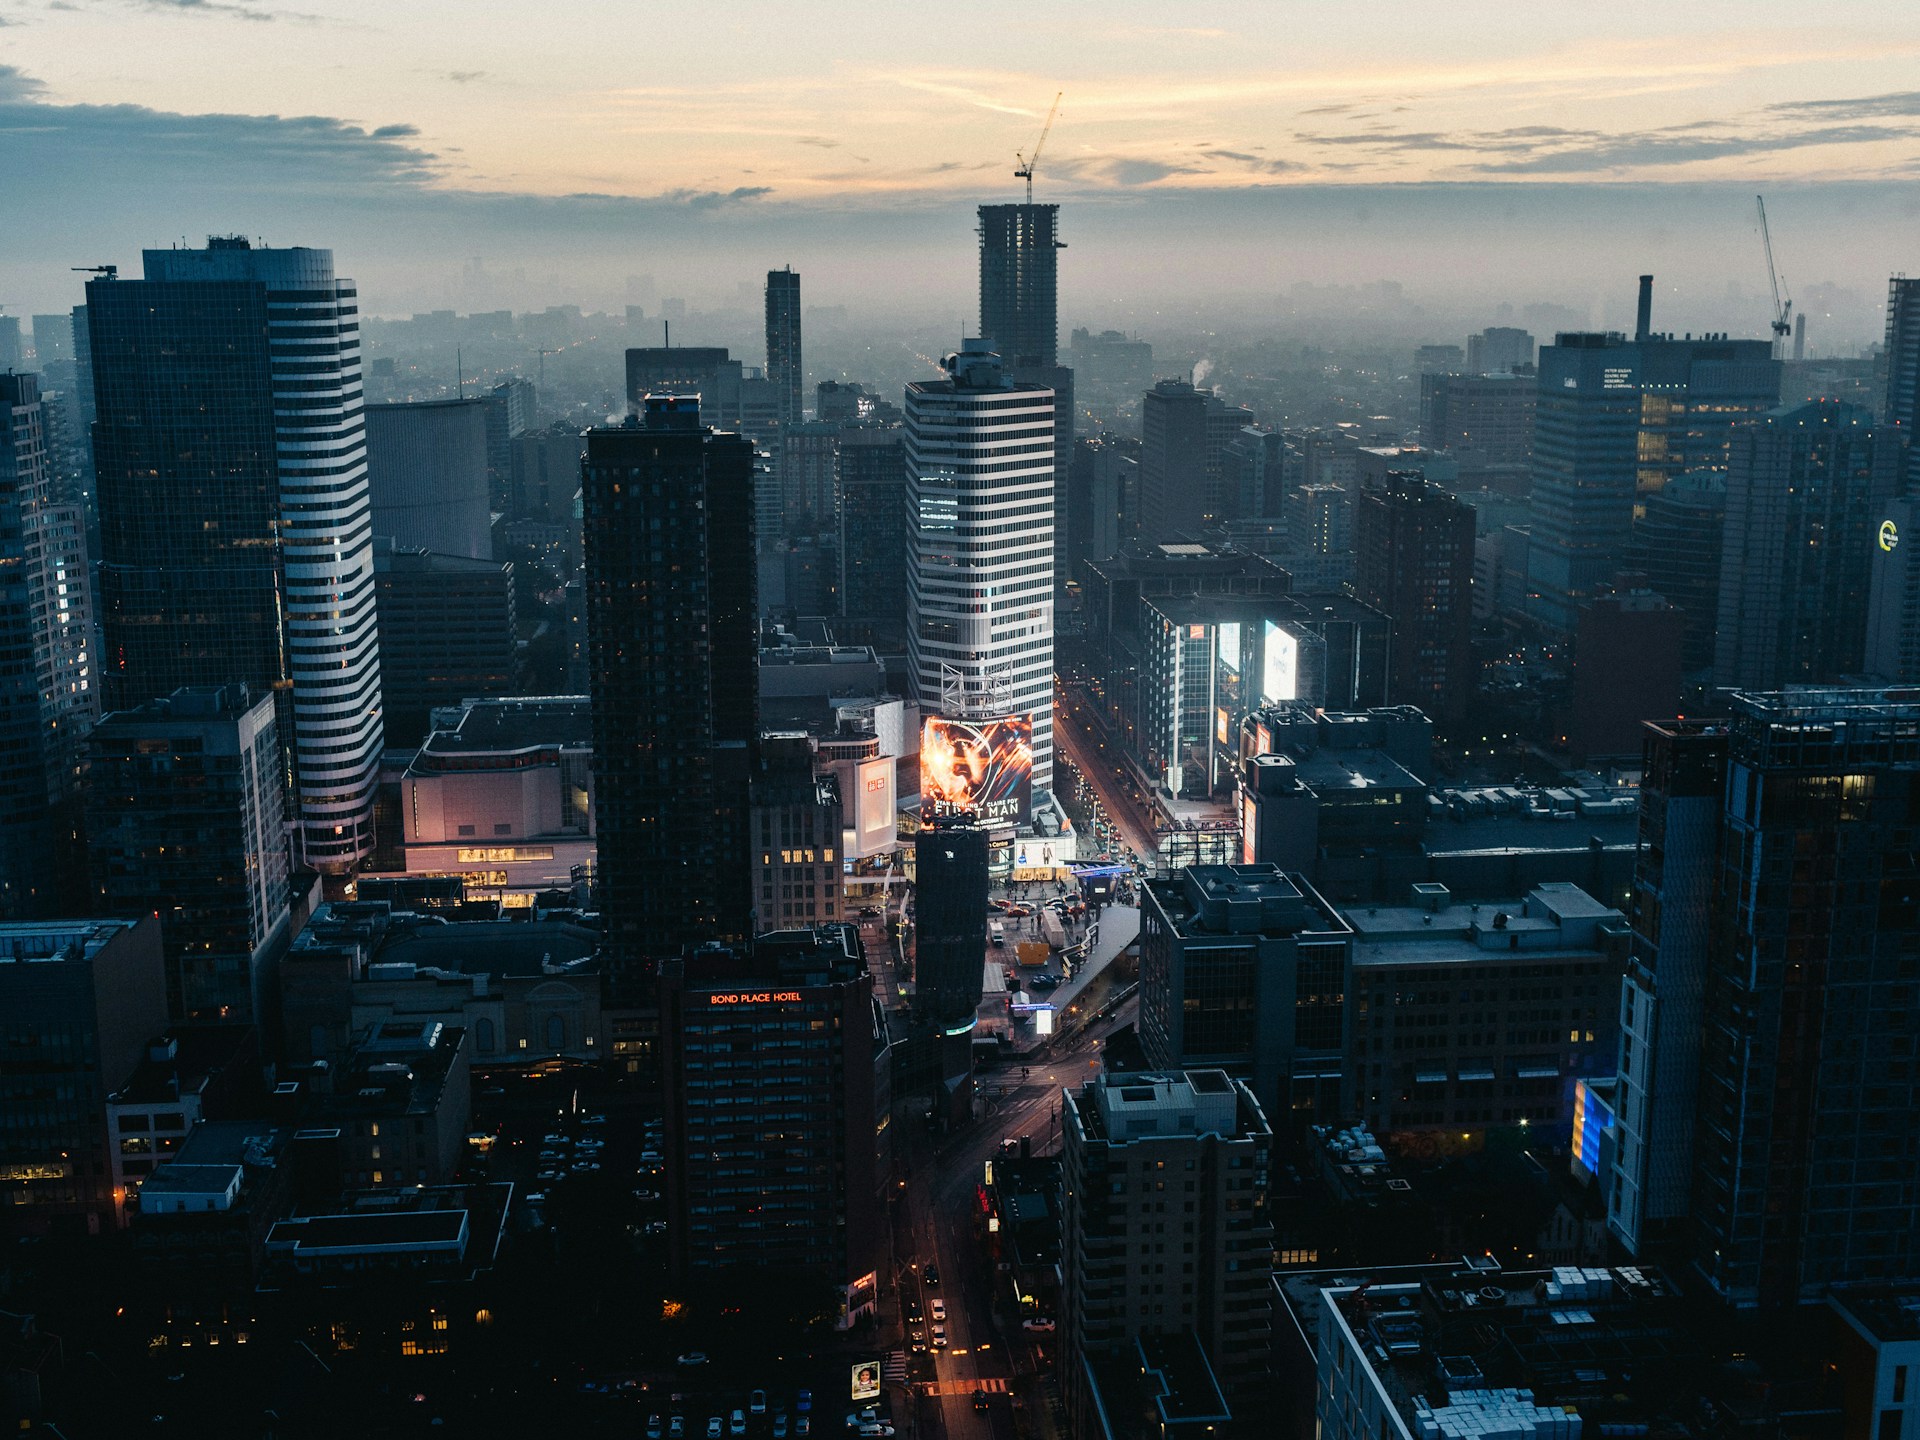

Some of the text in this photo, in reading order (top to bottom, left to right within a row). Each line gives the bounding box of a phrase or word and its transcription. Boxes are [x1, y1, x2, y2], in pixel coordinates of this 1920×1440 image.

[952, 801, 979, 809] GOSLING
[986, 800, 1006, 808] CLAIRE
[988, 803, 1019, 818] MAN
[711, 992, 801, 1005] BOND PLACE HOTEL
